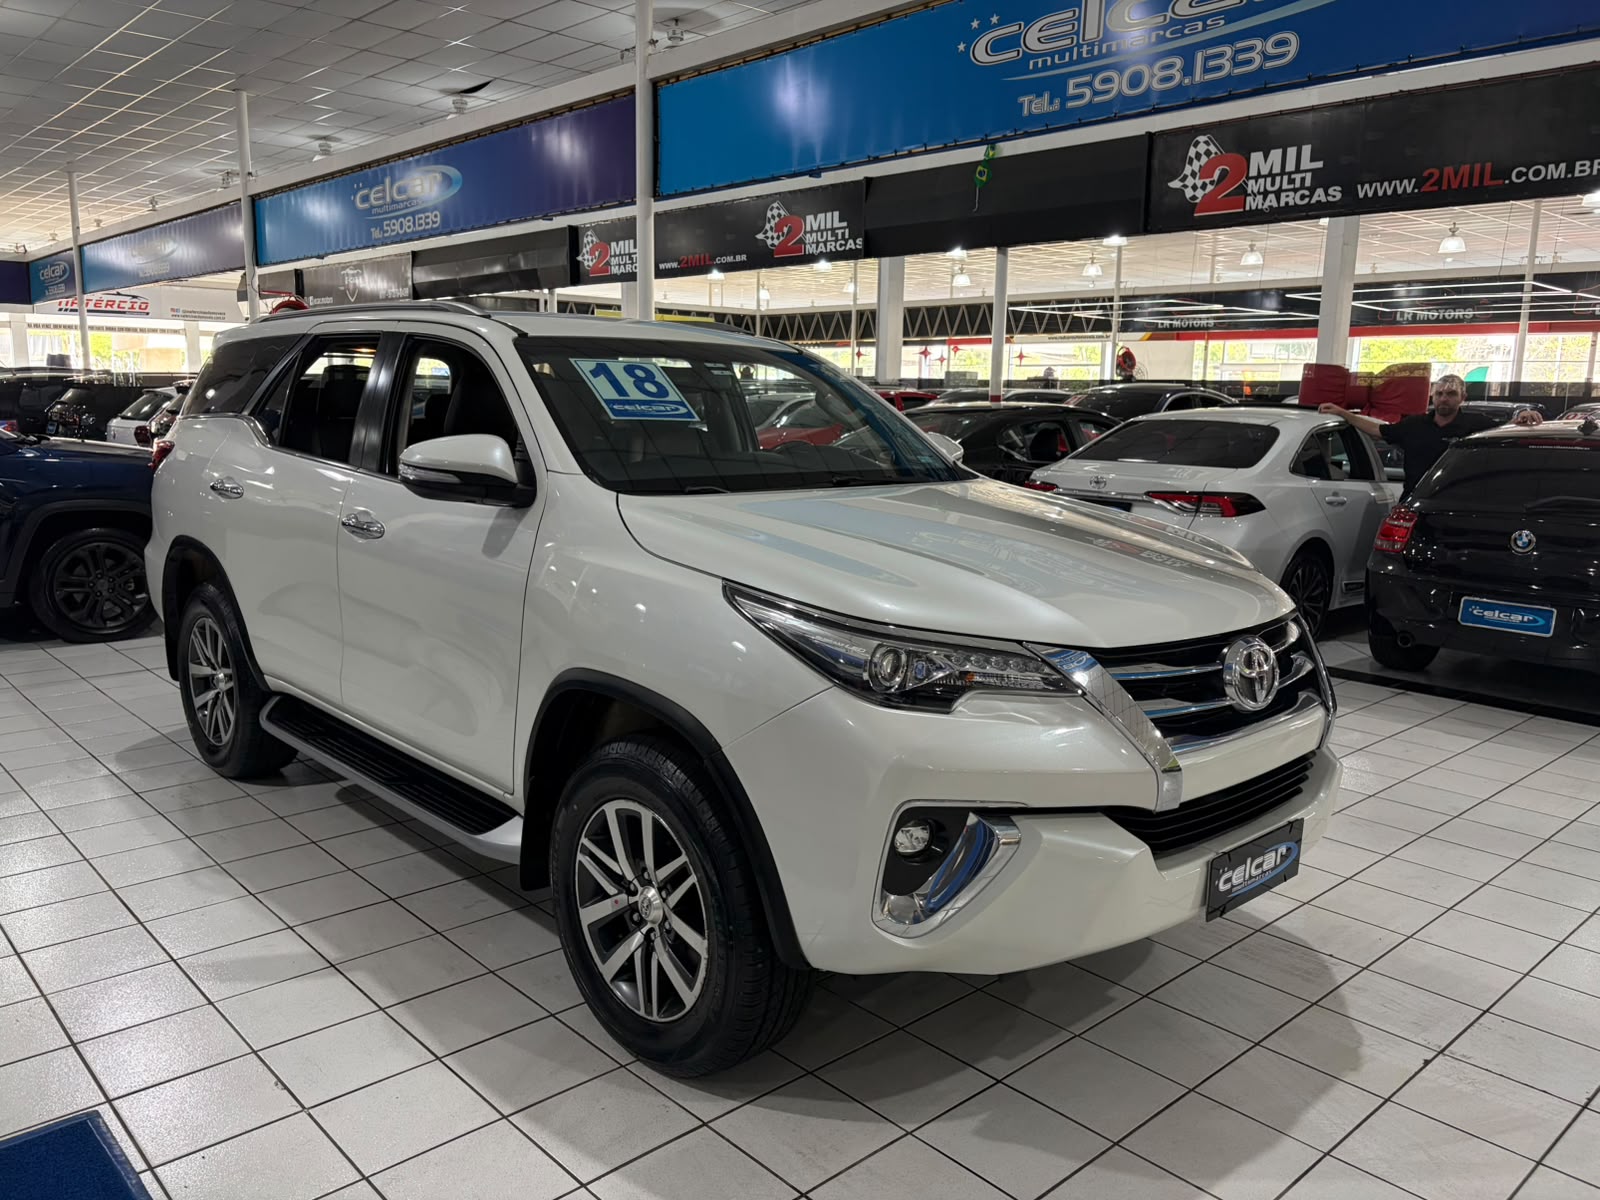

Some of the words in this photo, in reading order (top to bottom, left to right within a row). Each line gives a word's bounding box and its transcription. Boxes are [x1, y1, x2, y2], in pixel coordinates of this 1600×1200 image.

[1029, 14, 1225, 70] multimarcas
[1065, 31, 1300, 110] 5908.1339
[355, 172, 442, 209] celcar
[1194, 153, 1249, 216] 2
[1248, 144, 1324, 177] MIL
[1247, 172, 1312, 192] MULTI
[1245, 185, 1342, 211] MARCAS
[383, 211, 441, 238] 5908.1339
[774, 215, 805, 258] 2
[805, 211, 848, 232] MIL
[805, 230, 849, 243] MULTI
[589, 241, 611, 276] 2
[610, 239, 638, 255] MIL
[805, 237, 863, 255] MARCAS
[39, 264, 65, 280] celcar
[611, 254, 638, 265] MULT
[611, 264, 638, 276] MARC
[1172, 316, 1215, 328] MOTORS
[1396, 309, 1414, 321] LR
[1416, 307, 1474, 321] MOTORS
[588, 362, 670, 399] 18
[1472, 609, 1534, 623] celcar
[1218, 845, 1287, 892] celcar
